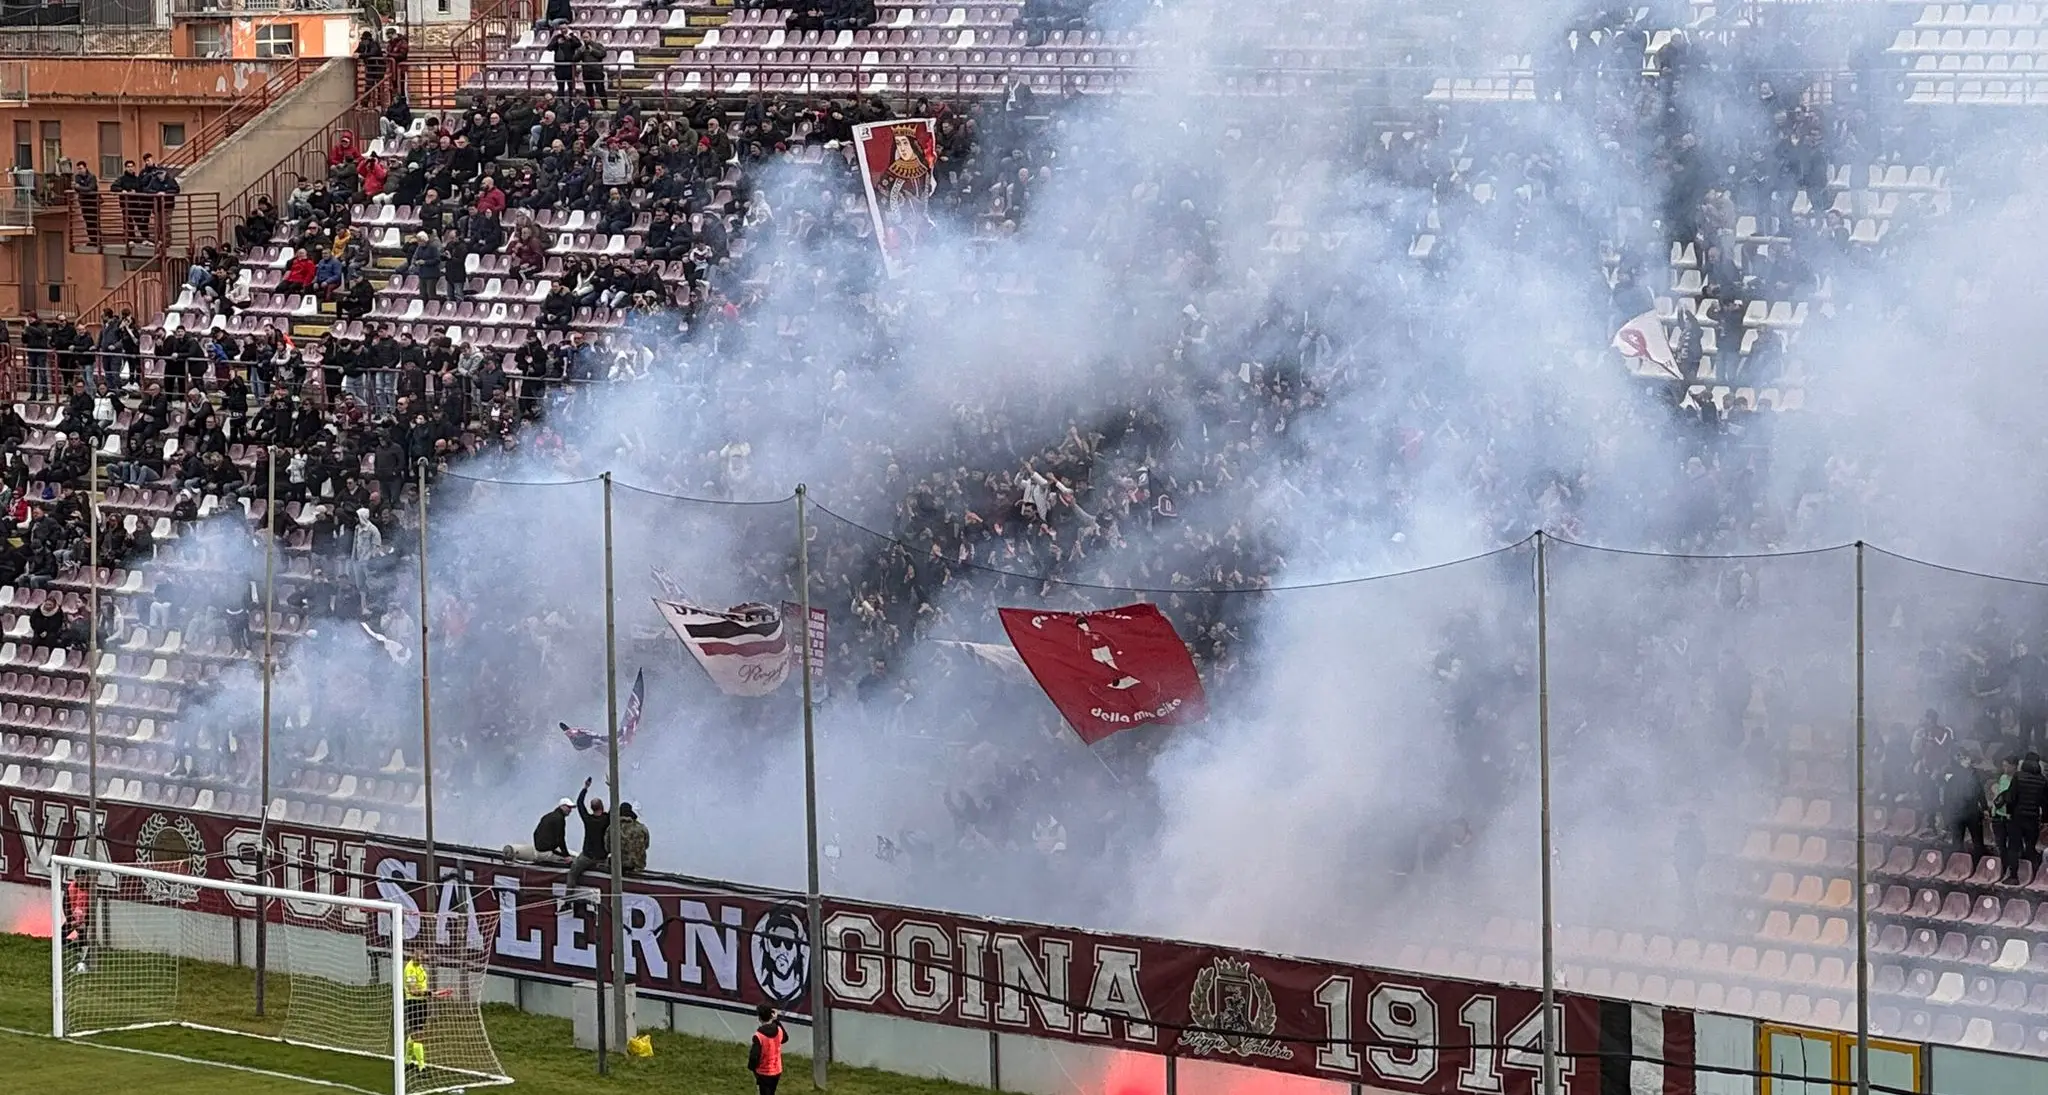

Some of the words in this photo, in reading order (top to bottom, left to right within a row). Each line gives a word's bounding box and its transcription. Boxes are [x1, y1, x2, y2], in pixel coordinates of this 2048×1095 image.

[1091, 707, 1130, 723] della
[822, 910, 1158, 1045] GGINA
[1313, 974, 1576, 1095] 1914
[1239, 1034, 1295, 1060] Calabria
